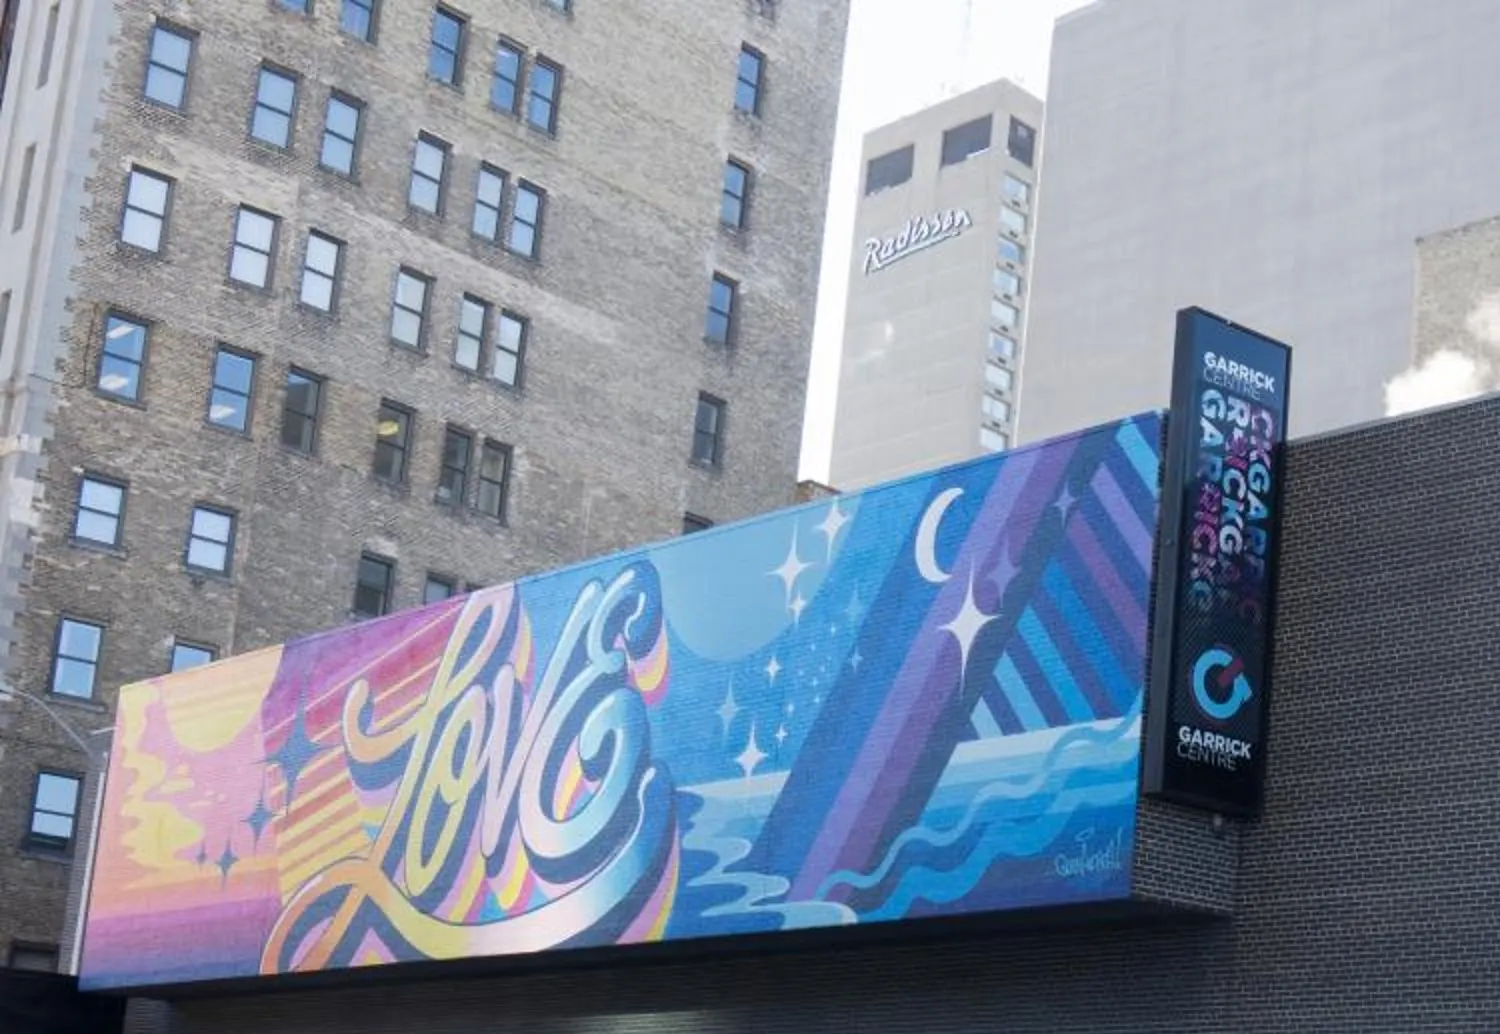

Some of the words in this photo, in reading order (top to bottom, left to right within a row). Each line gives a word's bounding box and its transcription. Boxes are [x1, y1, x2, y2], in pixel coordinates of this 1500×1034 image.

[864, 209, 973, 276] Radisson
[1203, 351, 1275, 393] GARRICK
[1177, 741, 1237, 771] CENTRE
[1179, 725, 1252, 760] GARRICK
